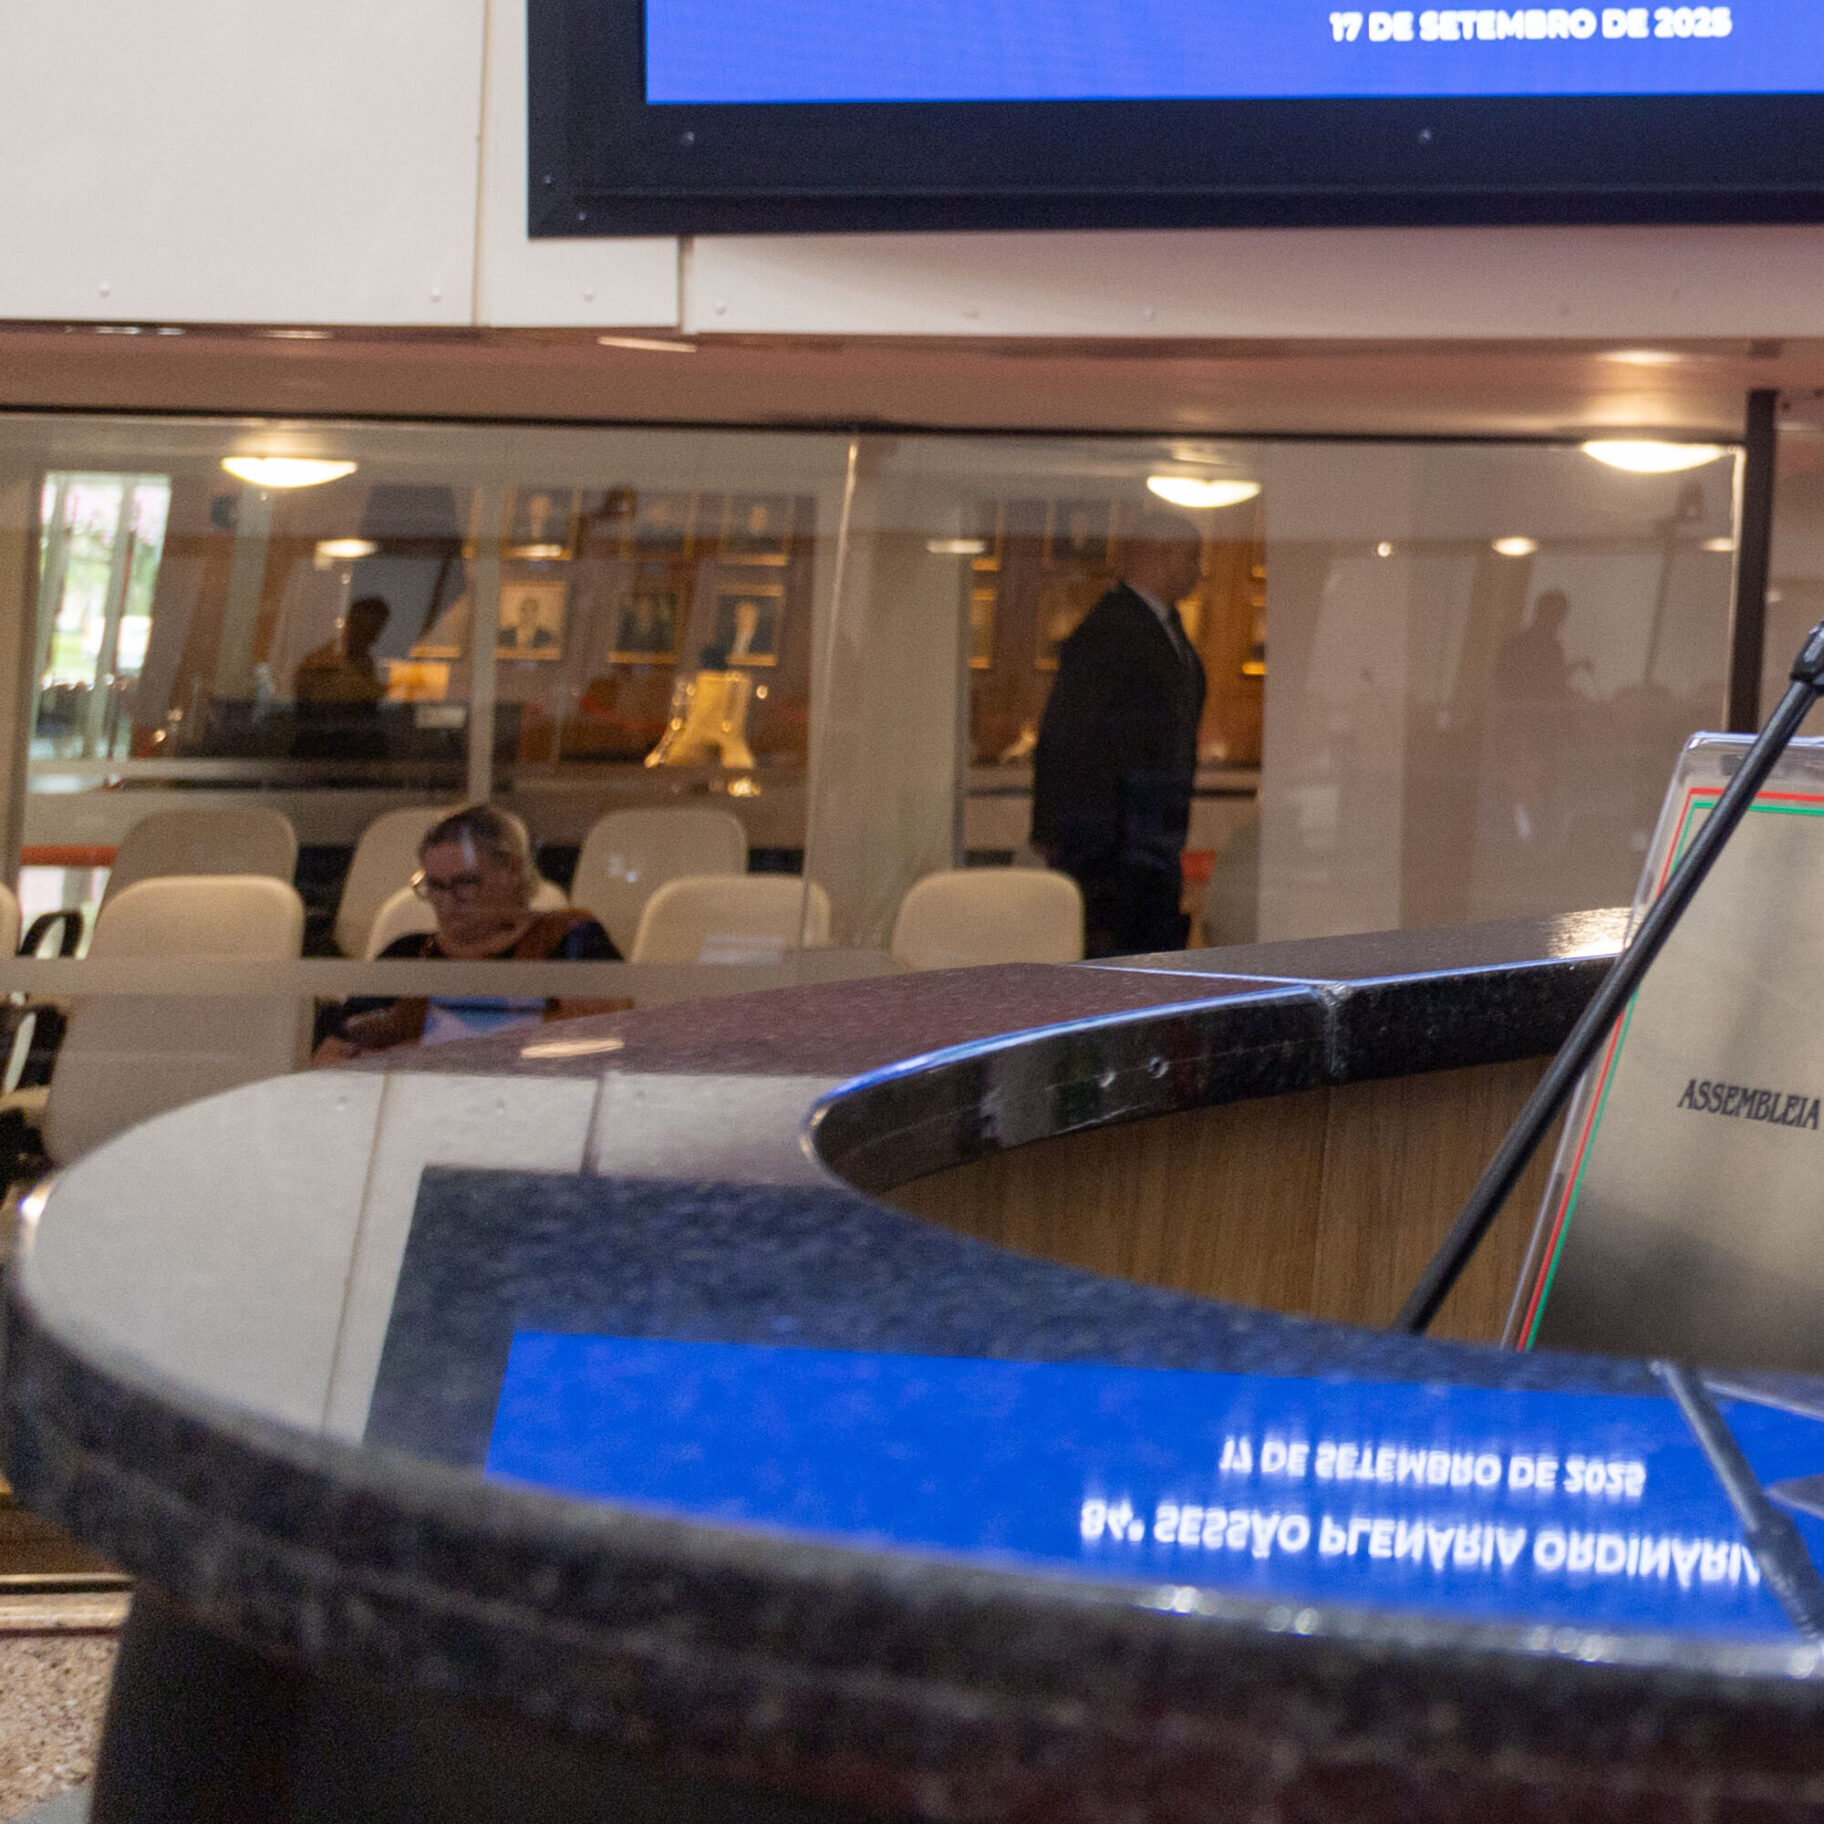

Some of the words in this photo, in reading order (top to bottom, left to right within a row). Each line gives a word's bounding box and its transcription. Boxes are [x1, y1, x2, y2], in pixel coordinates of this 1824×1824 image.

[1329, 11, 1364, 42] 17
[1368, 11, 1414, 42] DE
[1419, 8, 1597, 42] SETEMBRO
[1601, 8, 1650, 40] DE
[1653, 6, 1733, 38] 2025
[1677, 1078, 1821, 1131] ASSEMBLEIA
